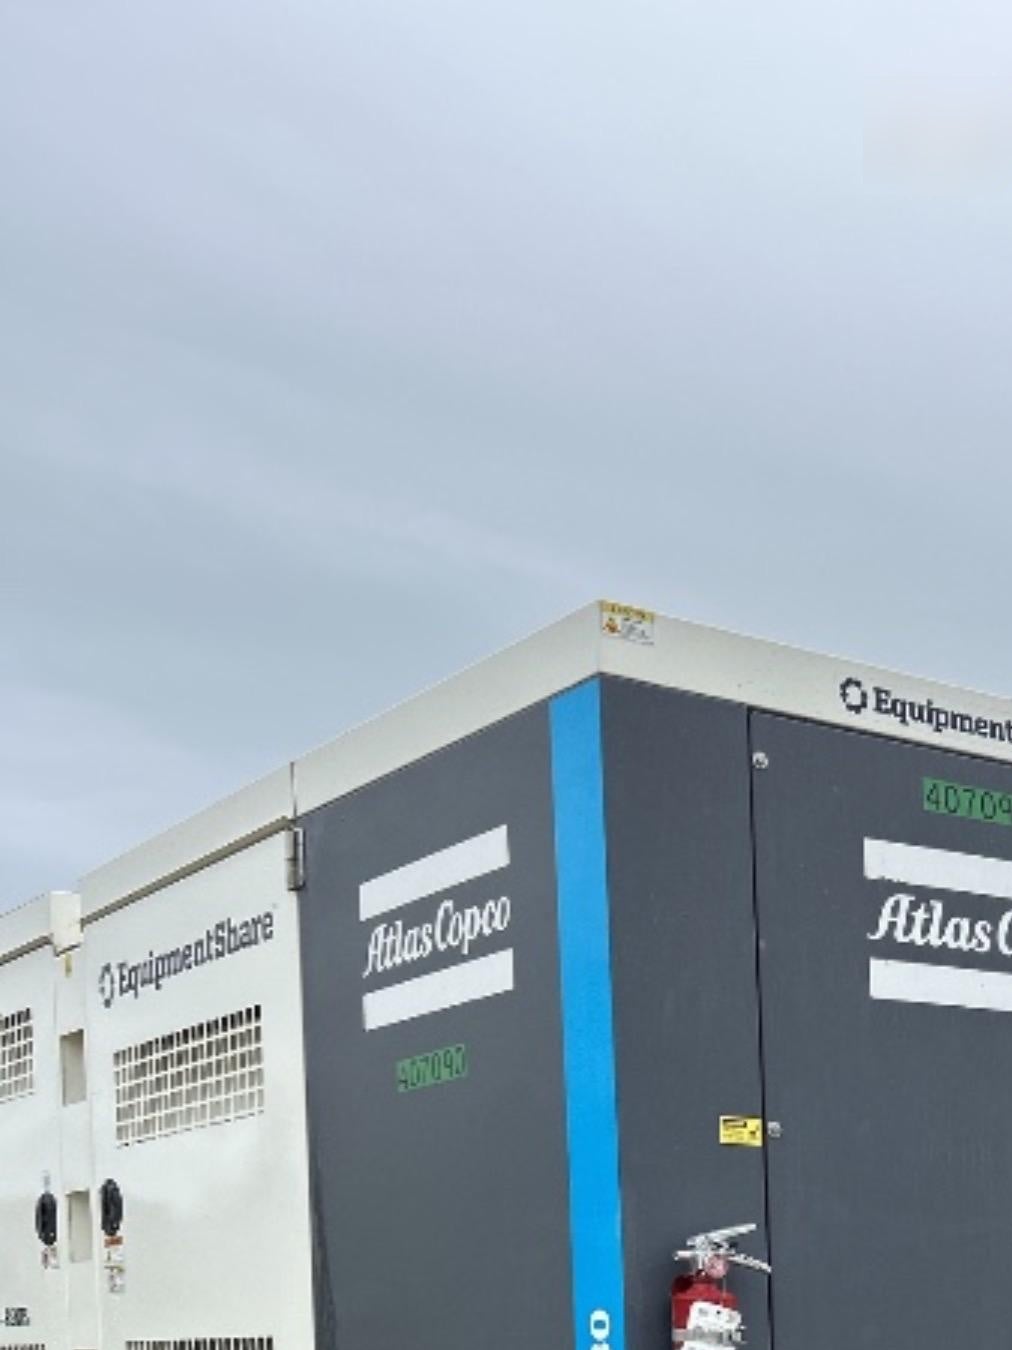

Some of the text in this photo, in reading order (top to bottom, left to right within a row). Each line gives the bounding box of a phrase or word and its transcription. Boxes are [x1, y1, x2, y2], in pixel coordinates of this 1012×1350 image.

[117, 911, 274, 999] EquipmentShare
[362, 896, 511, 979] Atlas Copco
[867, 893, 992, 953] Atlas
